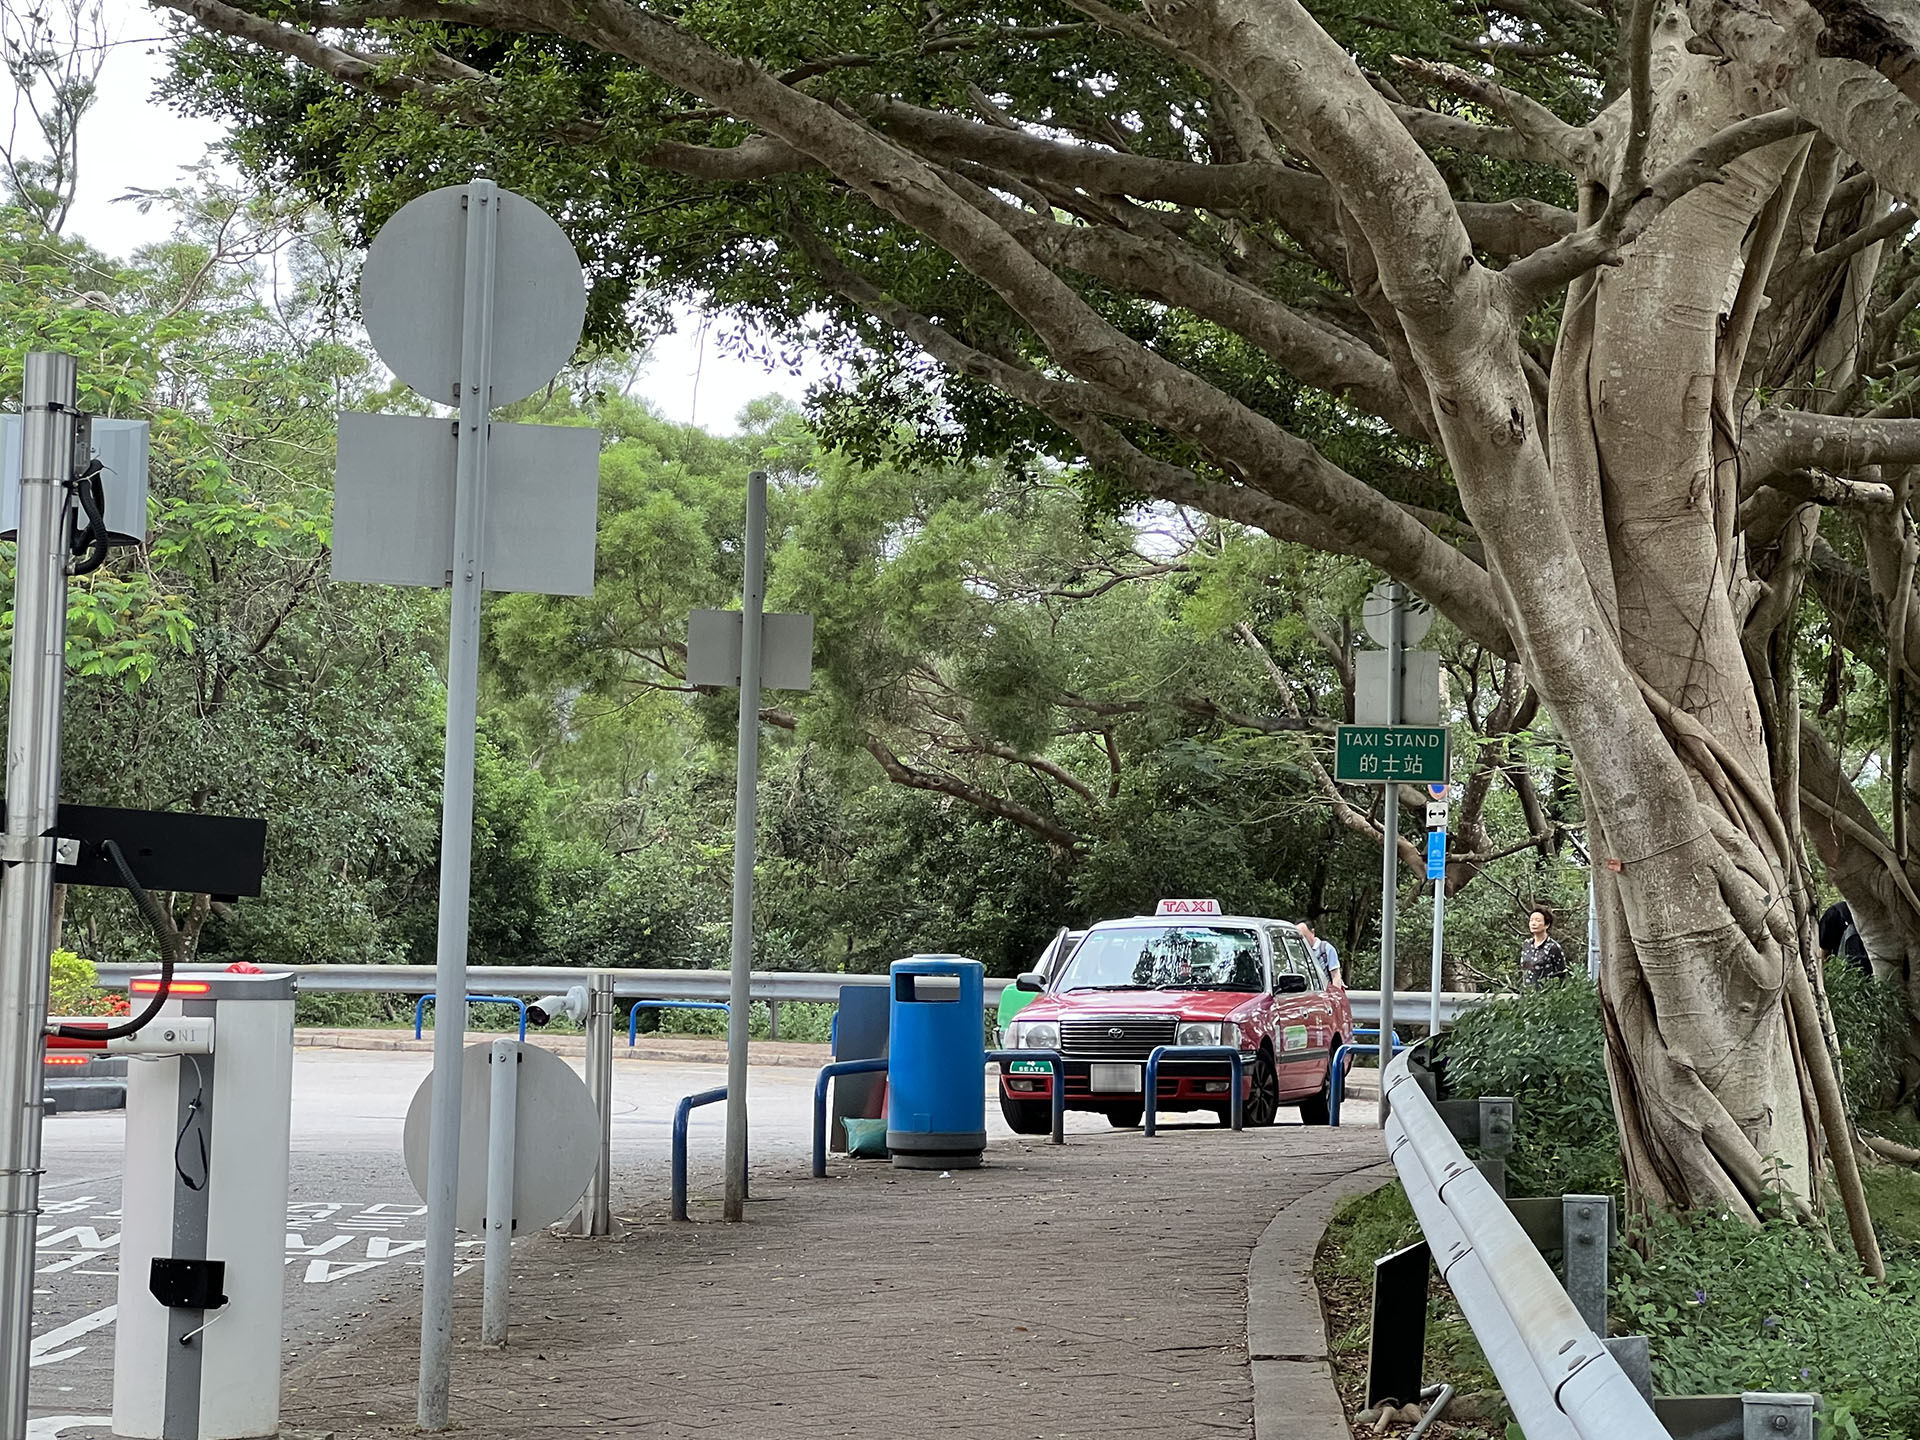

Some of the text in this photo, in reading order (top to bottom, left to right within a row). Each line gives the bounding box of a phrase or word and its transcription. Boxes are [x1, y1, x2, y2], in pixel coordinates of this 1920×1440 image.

[1344, 733, 1440, 748] TAXI STAND
[1359, 753, 1423, 774] 的士站
[1163, 901, 1213, 912] TAXI
